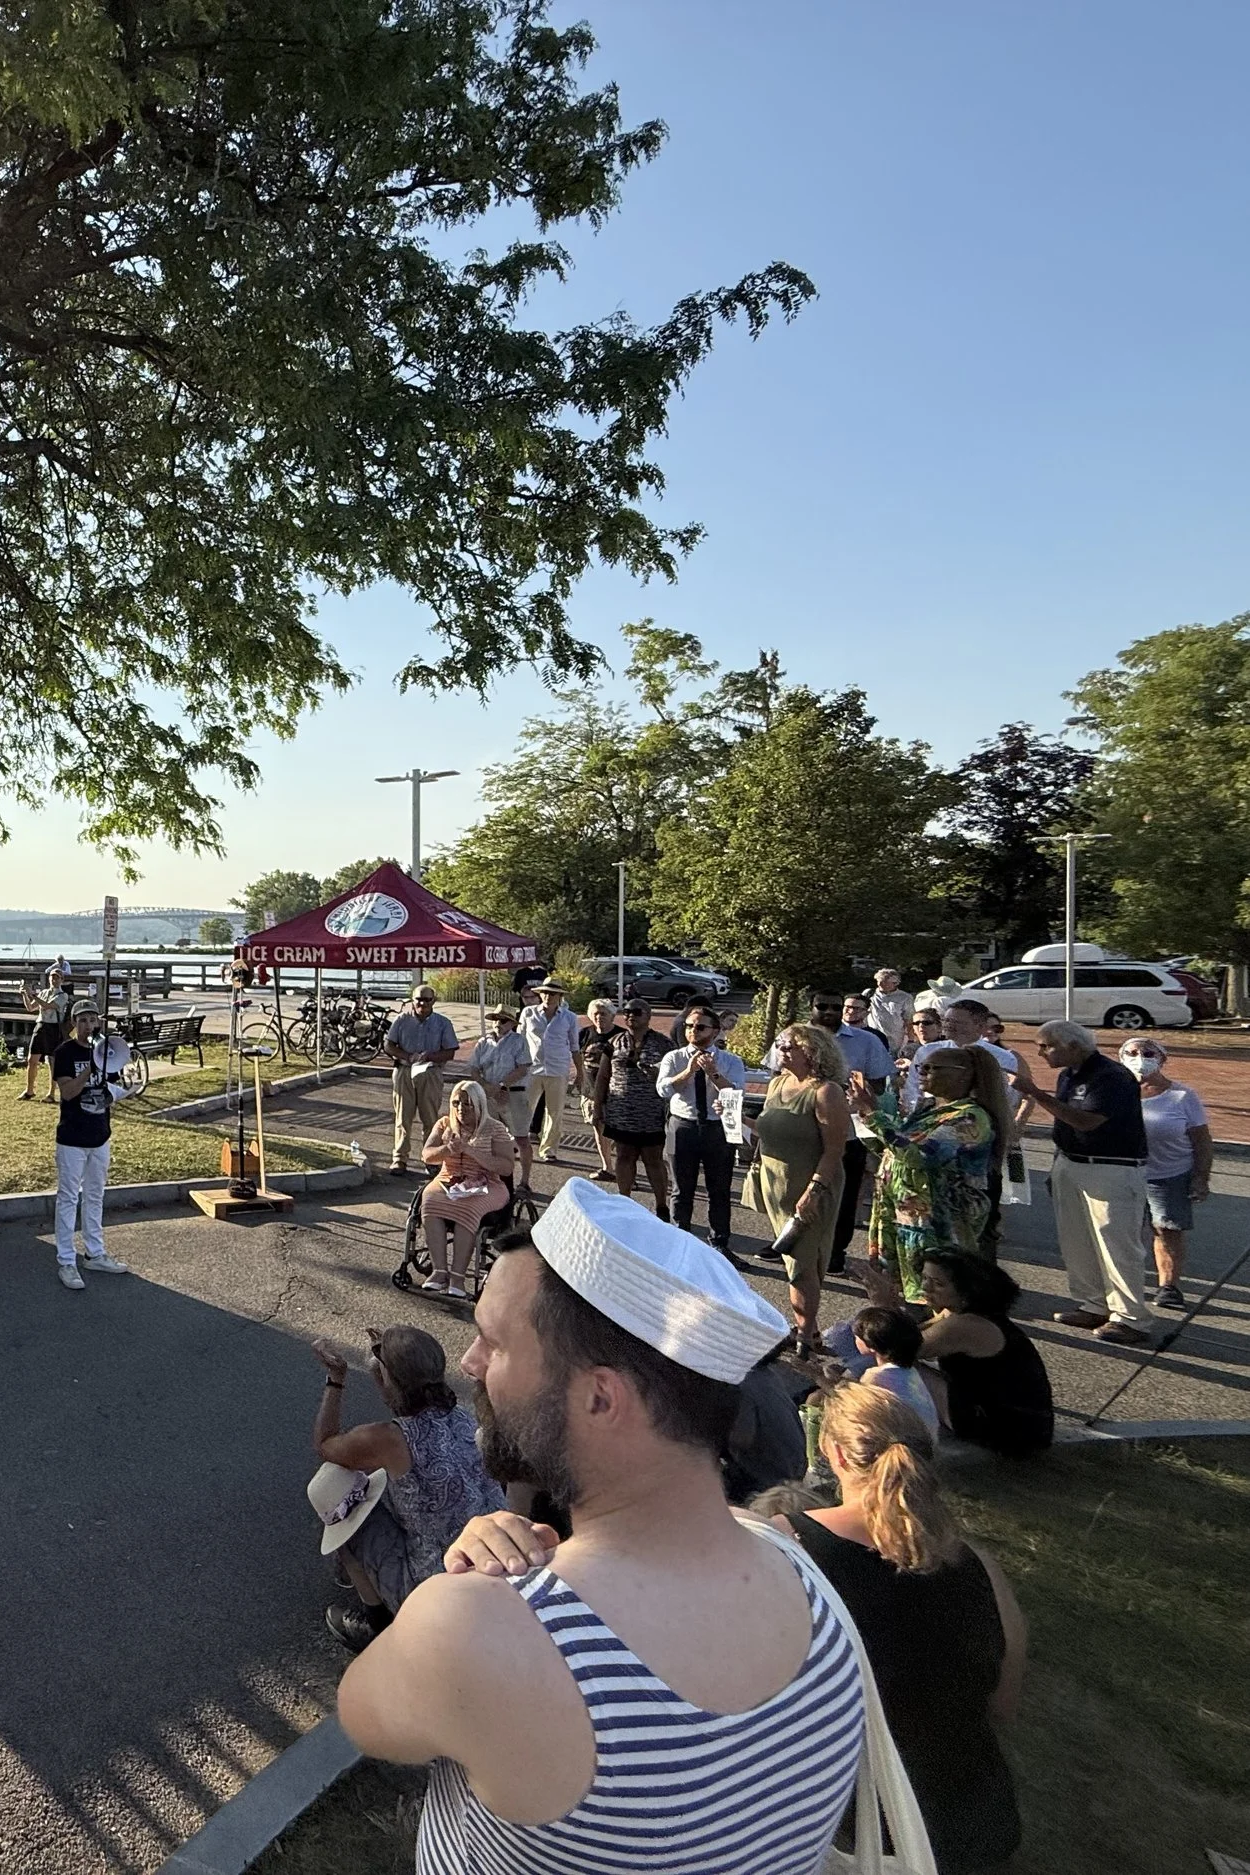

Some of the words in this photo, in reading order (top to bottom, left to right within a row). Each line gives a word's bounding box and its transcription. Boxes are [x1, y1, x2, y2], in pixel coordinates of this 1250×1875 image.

[247, 945, 268, 961] ICE
[273, 946, 326, 962] CREAM
[346, 946, 398, 963] SWEET
[404, 945, 467, 963] TREATS
